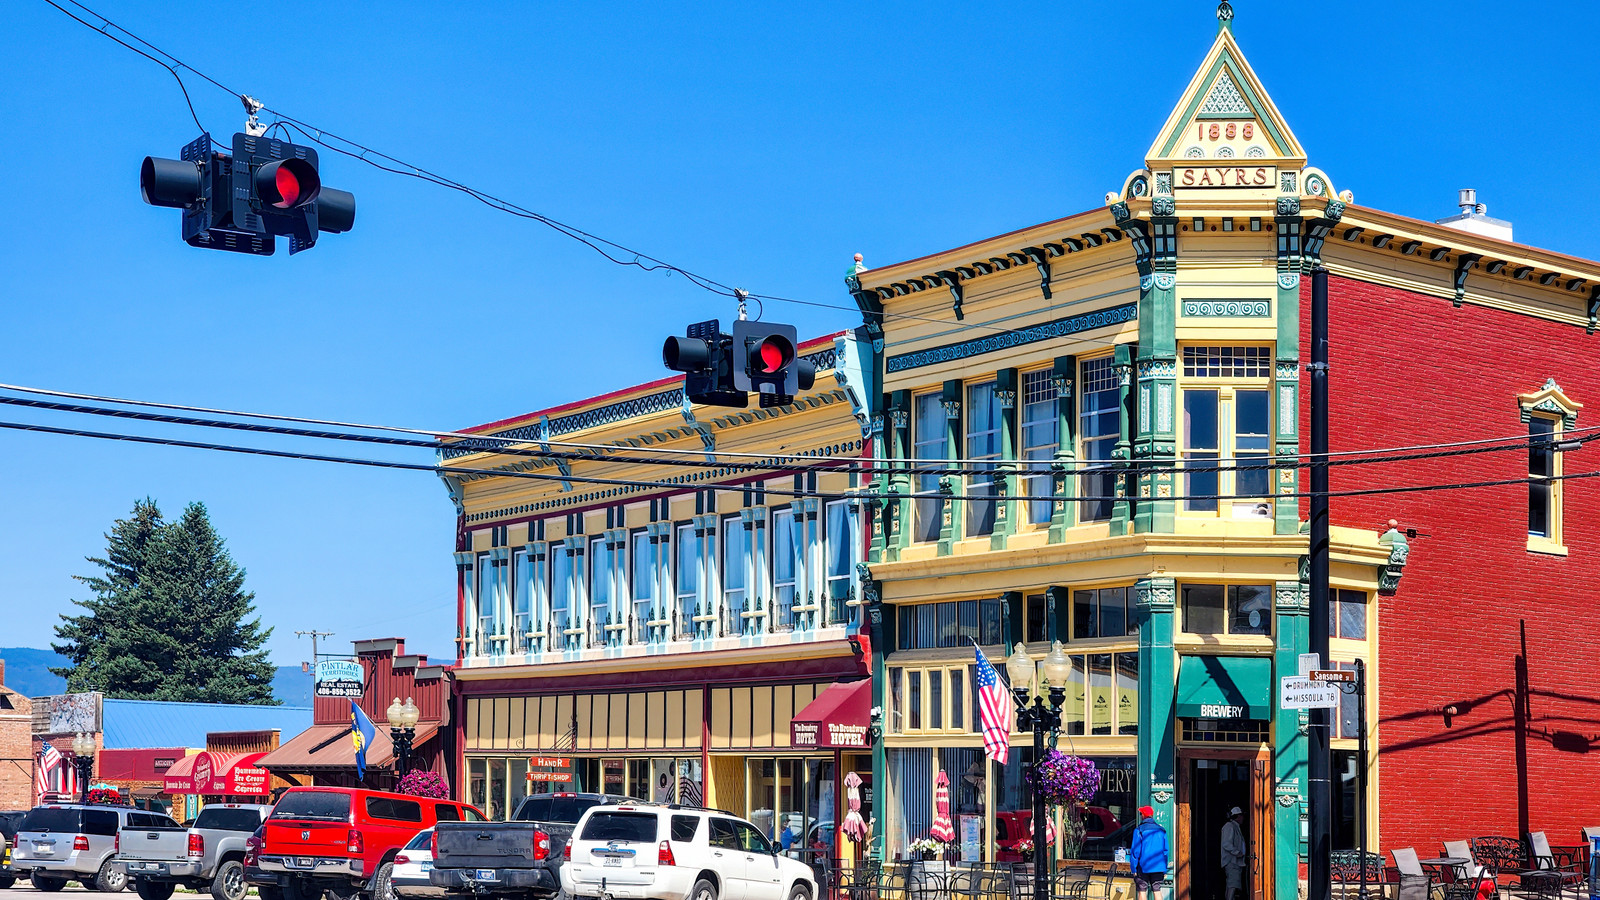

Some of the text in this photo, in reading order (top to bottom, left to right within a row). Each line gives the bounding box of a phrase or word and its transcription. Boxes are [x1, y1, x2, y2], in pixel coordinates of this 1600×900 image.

[1199, 123, 1254, 141] 1888
[1182, 168, 1267, 185] SAYRS
[321, 662, 359, 672] PINTLAR
[1314, 671, 1343, 680] Sansome
[1293, 681, 1325, 690] DRUMMOND
[1293, 693, 1324, 702] MISSOULA
[1201, 704, 1243, 718] BREWERY
[802, 724, 818, 733] Broadway
[828, 723, 866, 735] The Broadway
[796, 733, 816, 744] HOTEL
[831, 733, 864, 745] HOTEL
[234, 767, 265, 775] Homemade
[234, 785, 263, 793] Espresso
